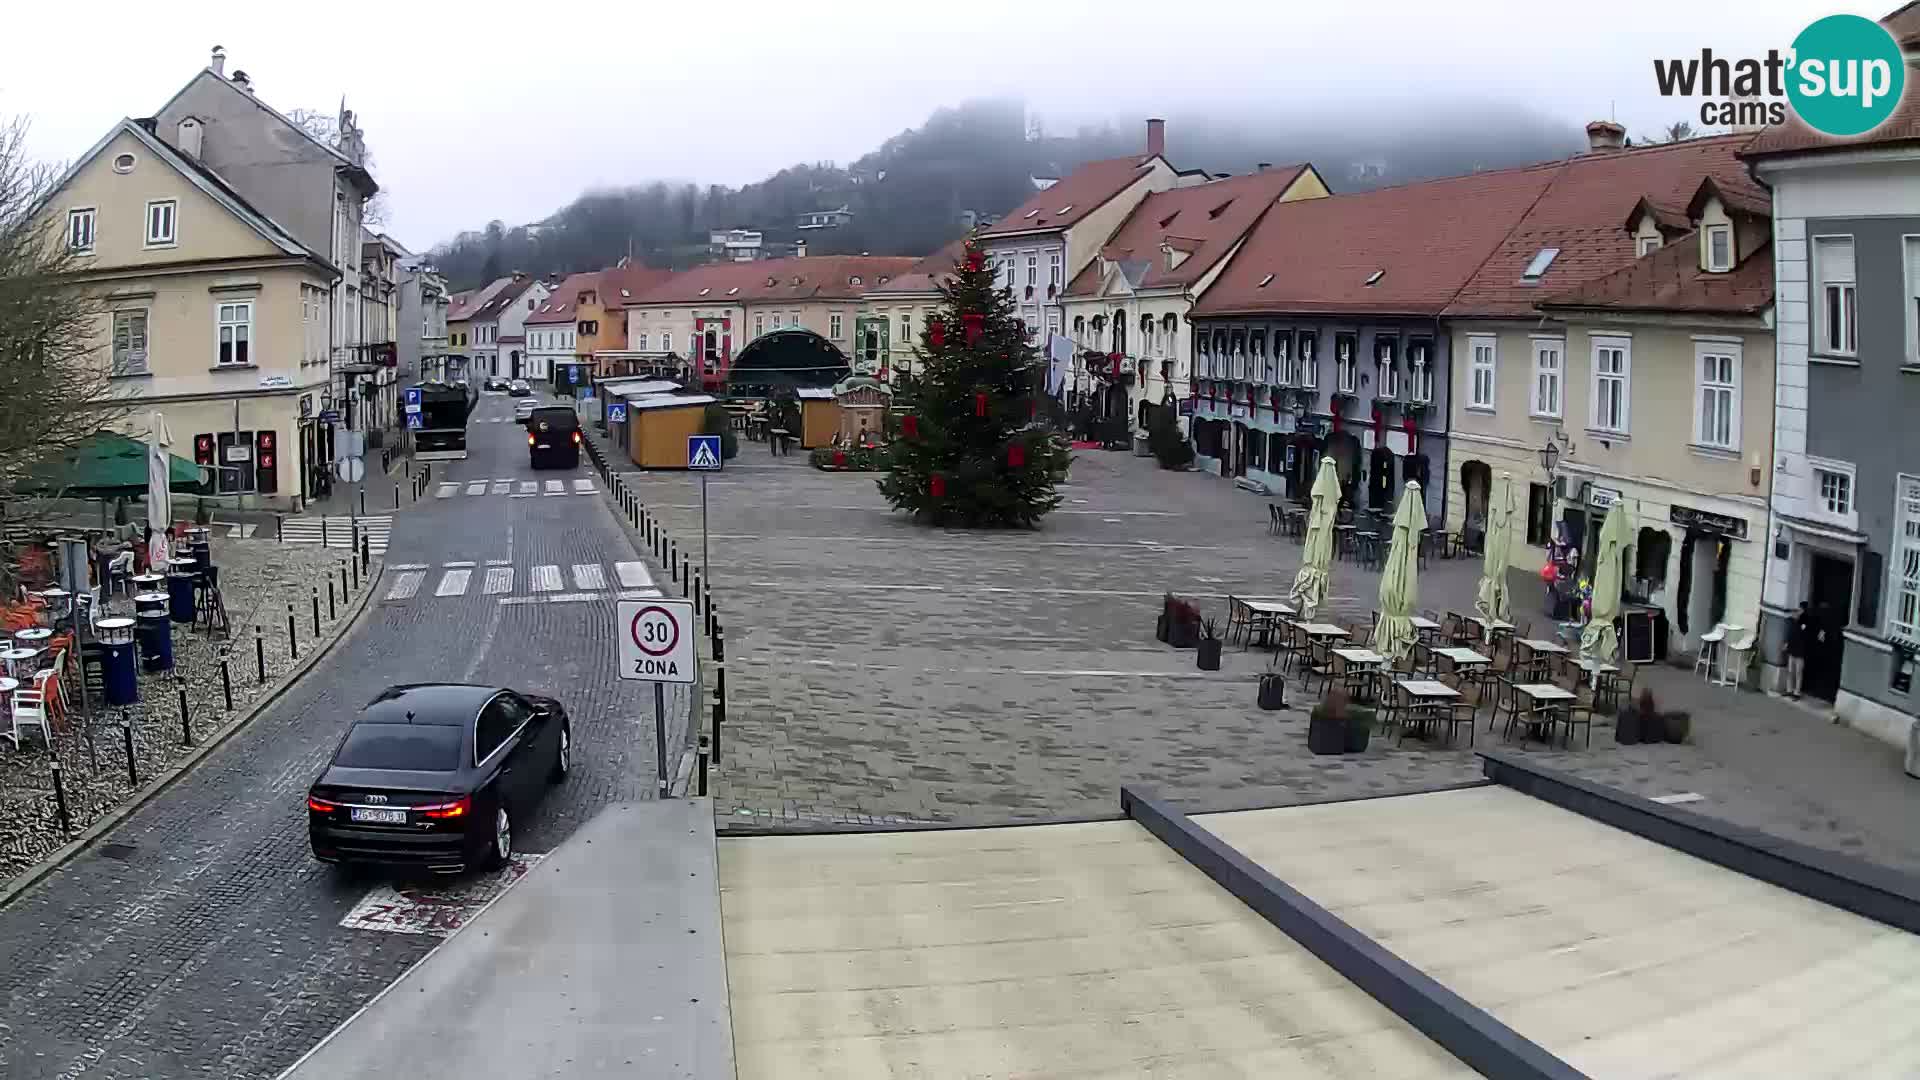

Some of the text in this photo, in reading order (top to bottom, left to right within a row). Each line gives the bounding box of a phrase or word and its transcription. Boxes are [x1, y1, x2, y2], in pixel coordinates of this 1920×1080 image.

[409, 391, 417, 402] P
[644, 621, 668, 643] 30
[634, 659, 678, 675] ZONA
